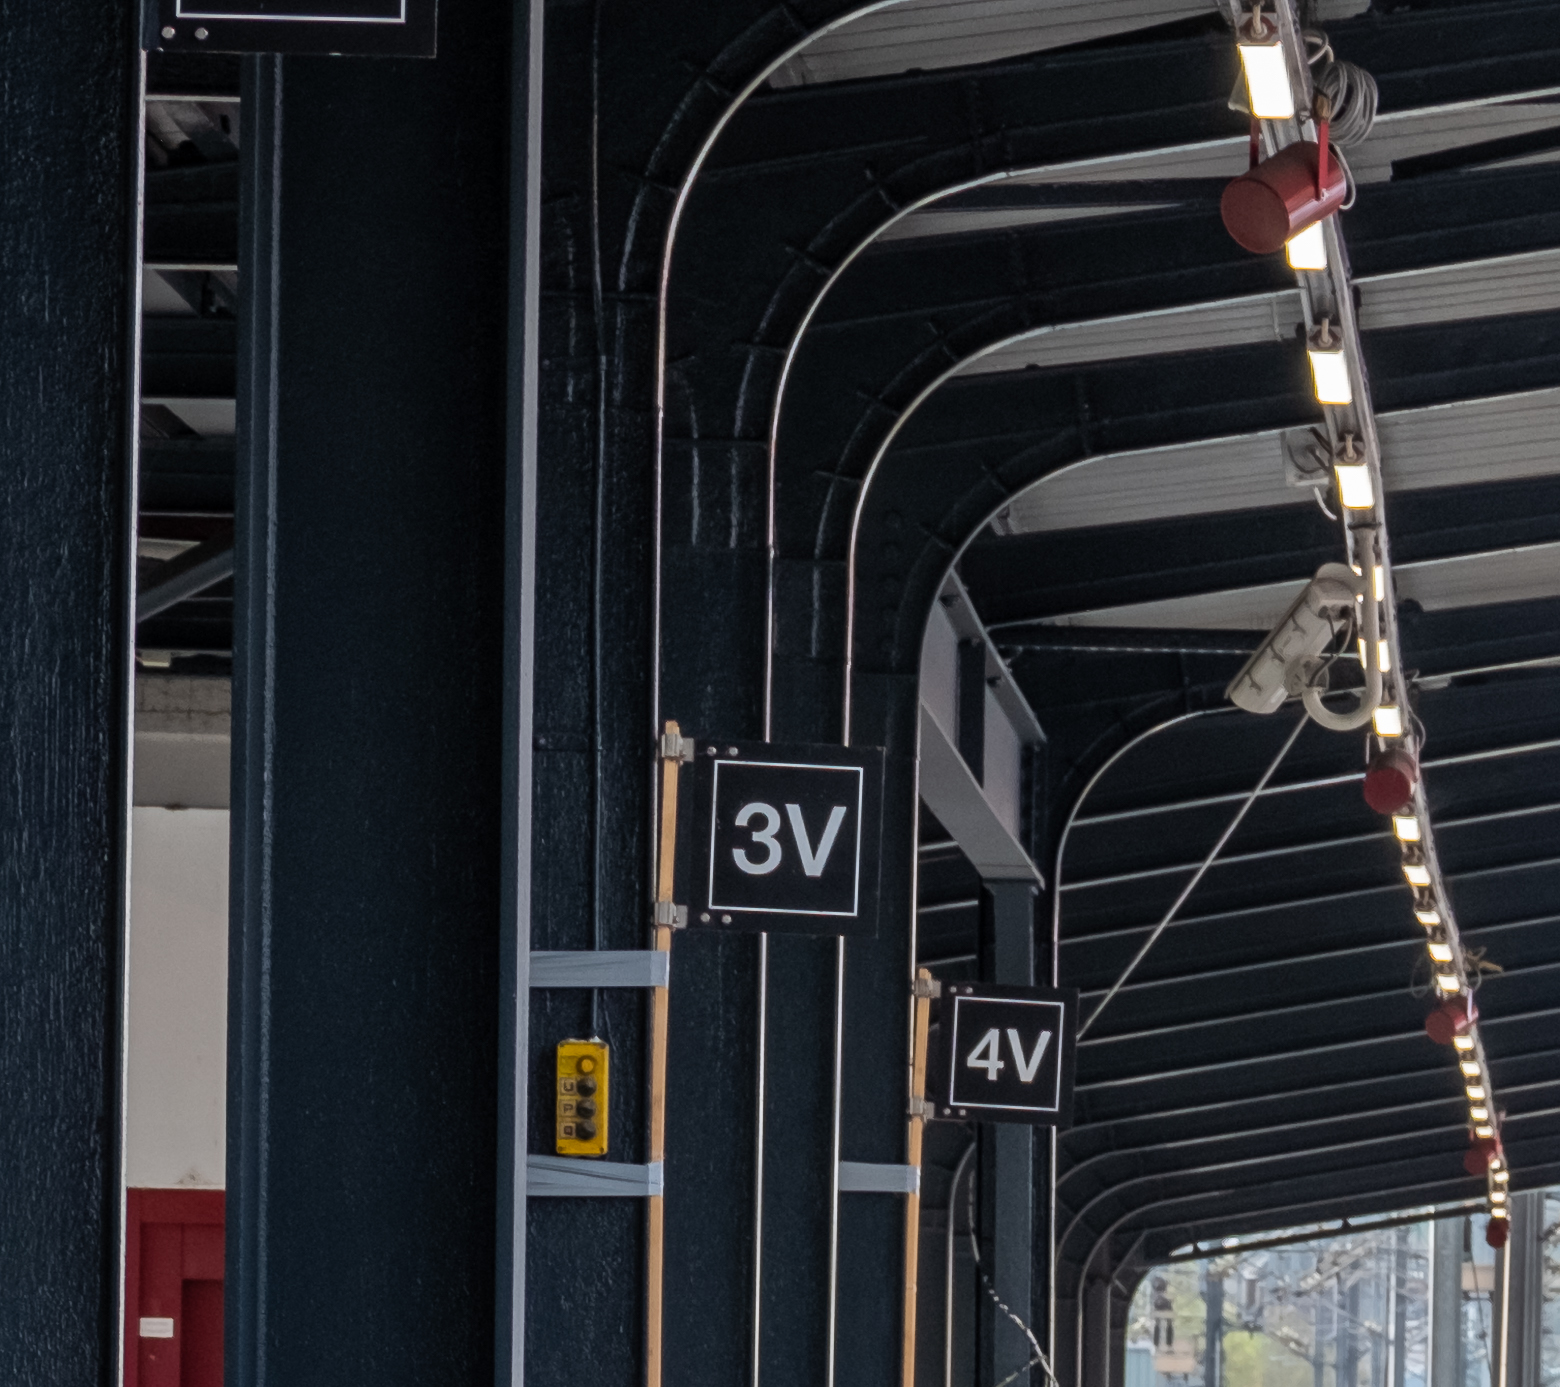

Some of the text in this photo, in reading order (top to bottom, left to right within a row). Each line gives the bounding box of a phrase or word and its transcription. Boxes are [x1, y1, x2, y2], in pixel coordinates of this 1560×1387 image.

[732, 802, 847, 877] 3V
[966, 1028, 1052, 1082] 4V
[563, 1081, 574, 1092] U
[563, 1103, 574, 1114] P
